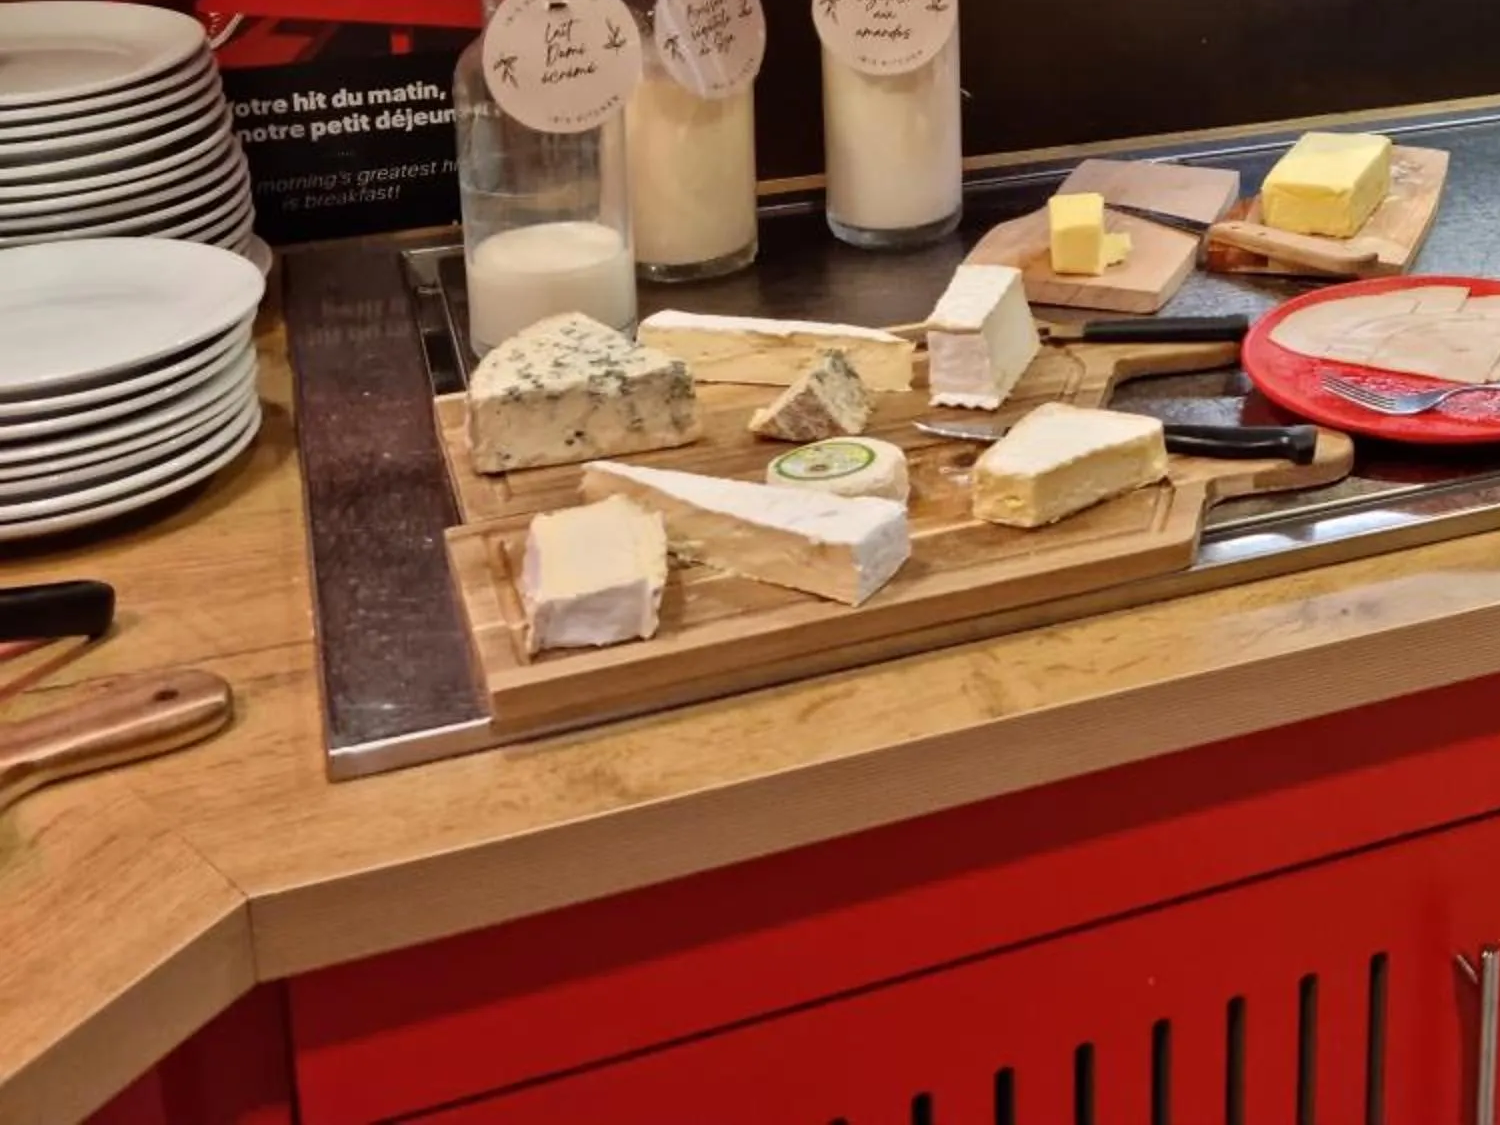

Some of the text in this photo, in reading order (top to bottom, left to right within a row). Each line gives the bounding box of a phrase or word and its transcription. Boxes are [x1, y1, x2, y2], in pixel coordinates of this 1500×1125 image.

[228, 80, 447, 116] otre hit du matin,
[310, 111, 371, 142] petit
[356, 159, 437, 186] greatest
